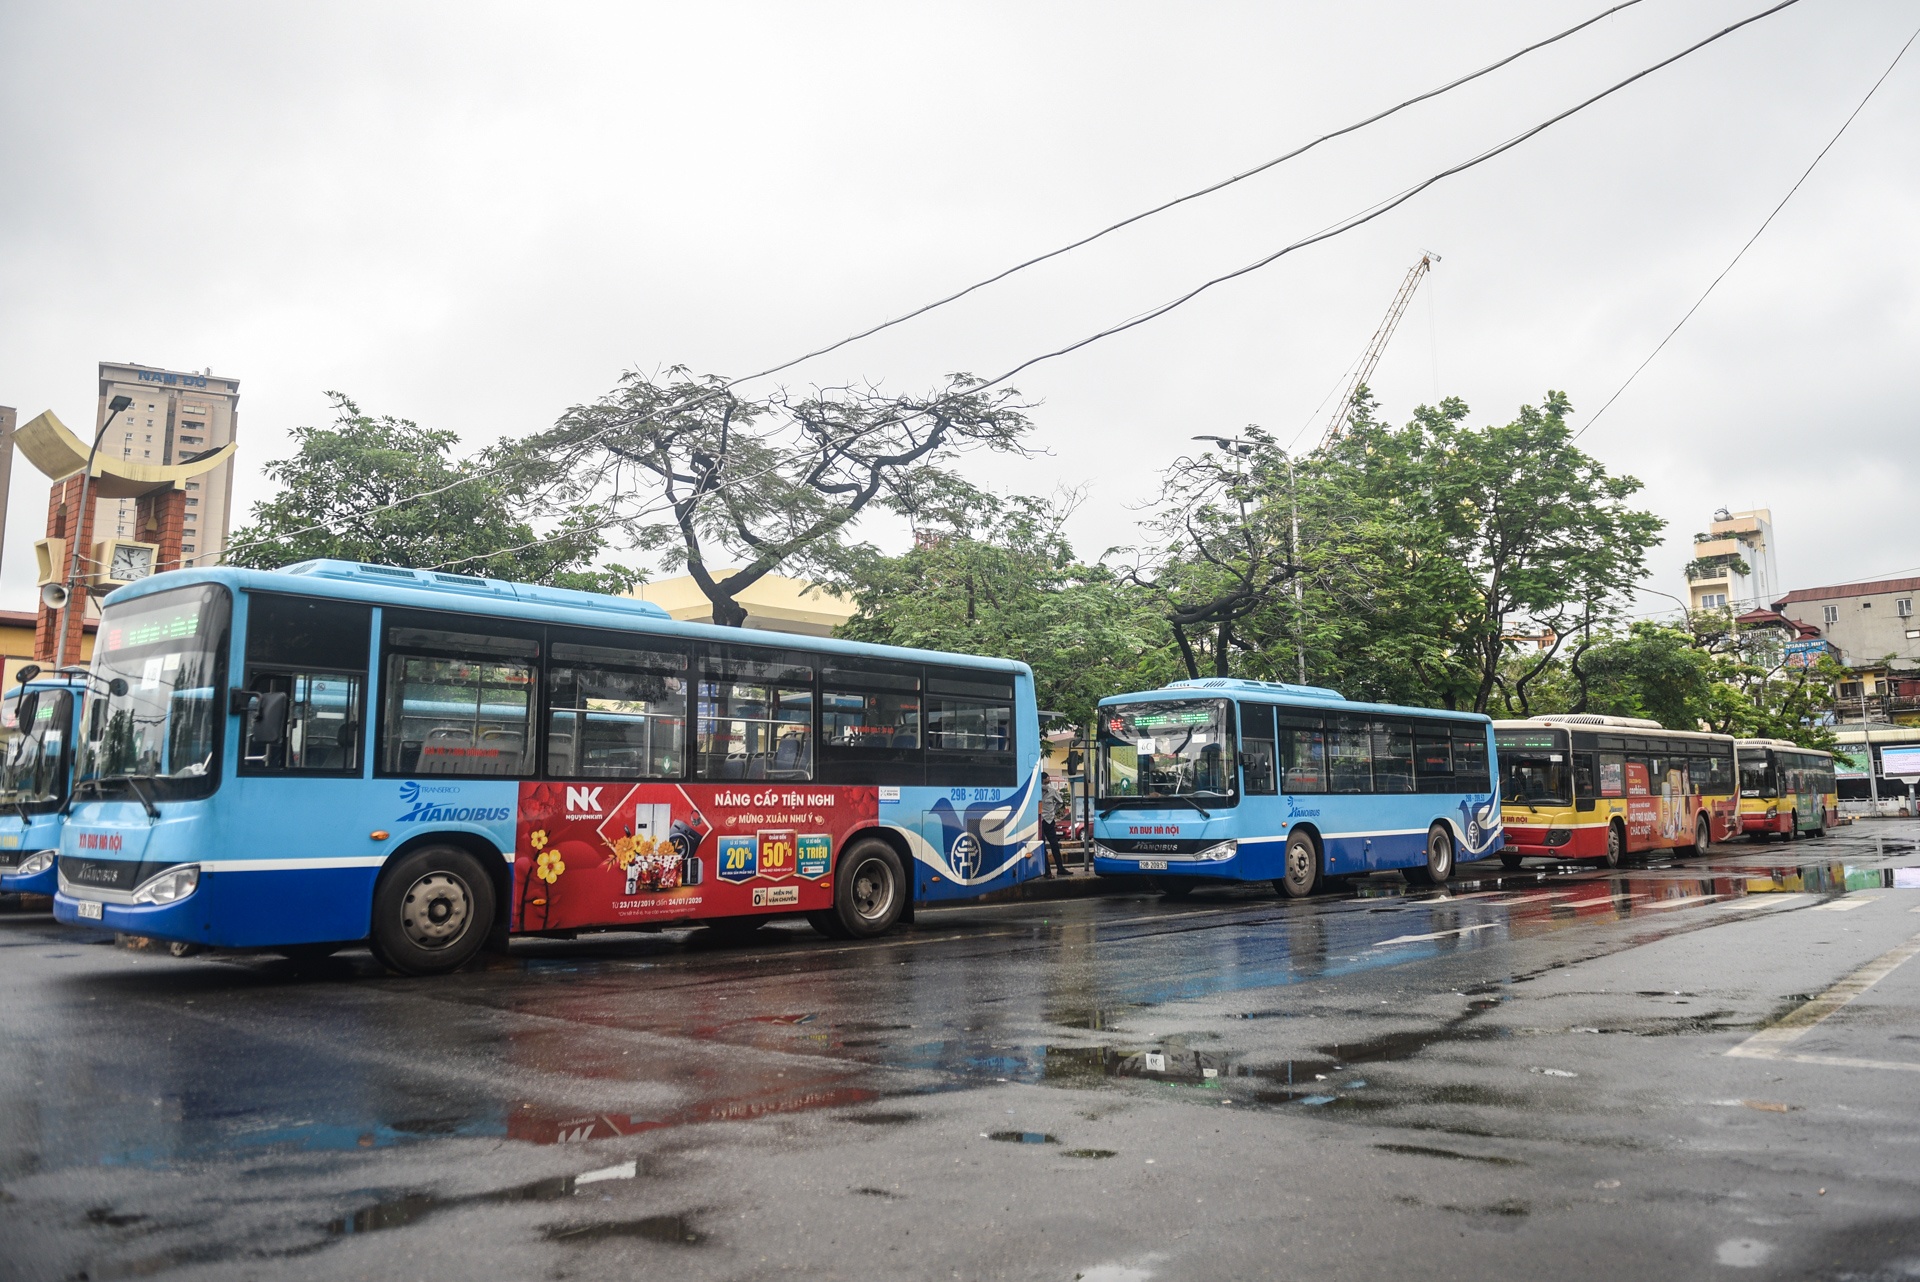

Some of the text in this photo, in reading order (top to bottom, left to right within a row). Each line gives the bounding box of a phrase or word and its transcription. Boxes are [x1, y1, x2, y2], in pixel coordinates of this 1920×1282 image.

[138, 370, 177, 384] NAM
[421, 786, 460, 794] TRANSERCO
[950, 788, 966, 801] 29B
[974, 788, 1000, 801] 207.30
[566, 786, 604, 811] NK
[715, 789, 835, 809] NÂNG CẤP TIỆN NGHI
[395, 802, 510, 822] HANOIBUS
[739, 812, 814, 823] MỪNG XUÂN NHƯ Ý
[1154, 824, 1164, 834] HÀ
[1166, 824, 1179, 836] NỘI
[726, 847, 752, 869] 20%
[763, 842, 792, 867] 50%
[799, 845, 828, 861] 5 TRIỆU
[620, 899, 655, 909] 23/12/2019
[669, 897, 703, 906] 24/01/2020
